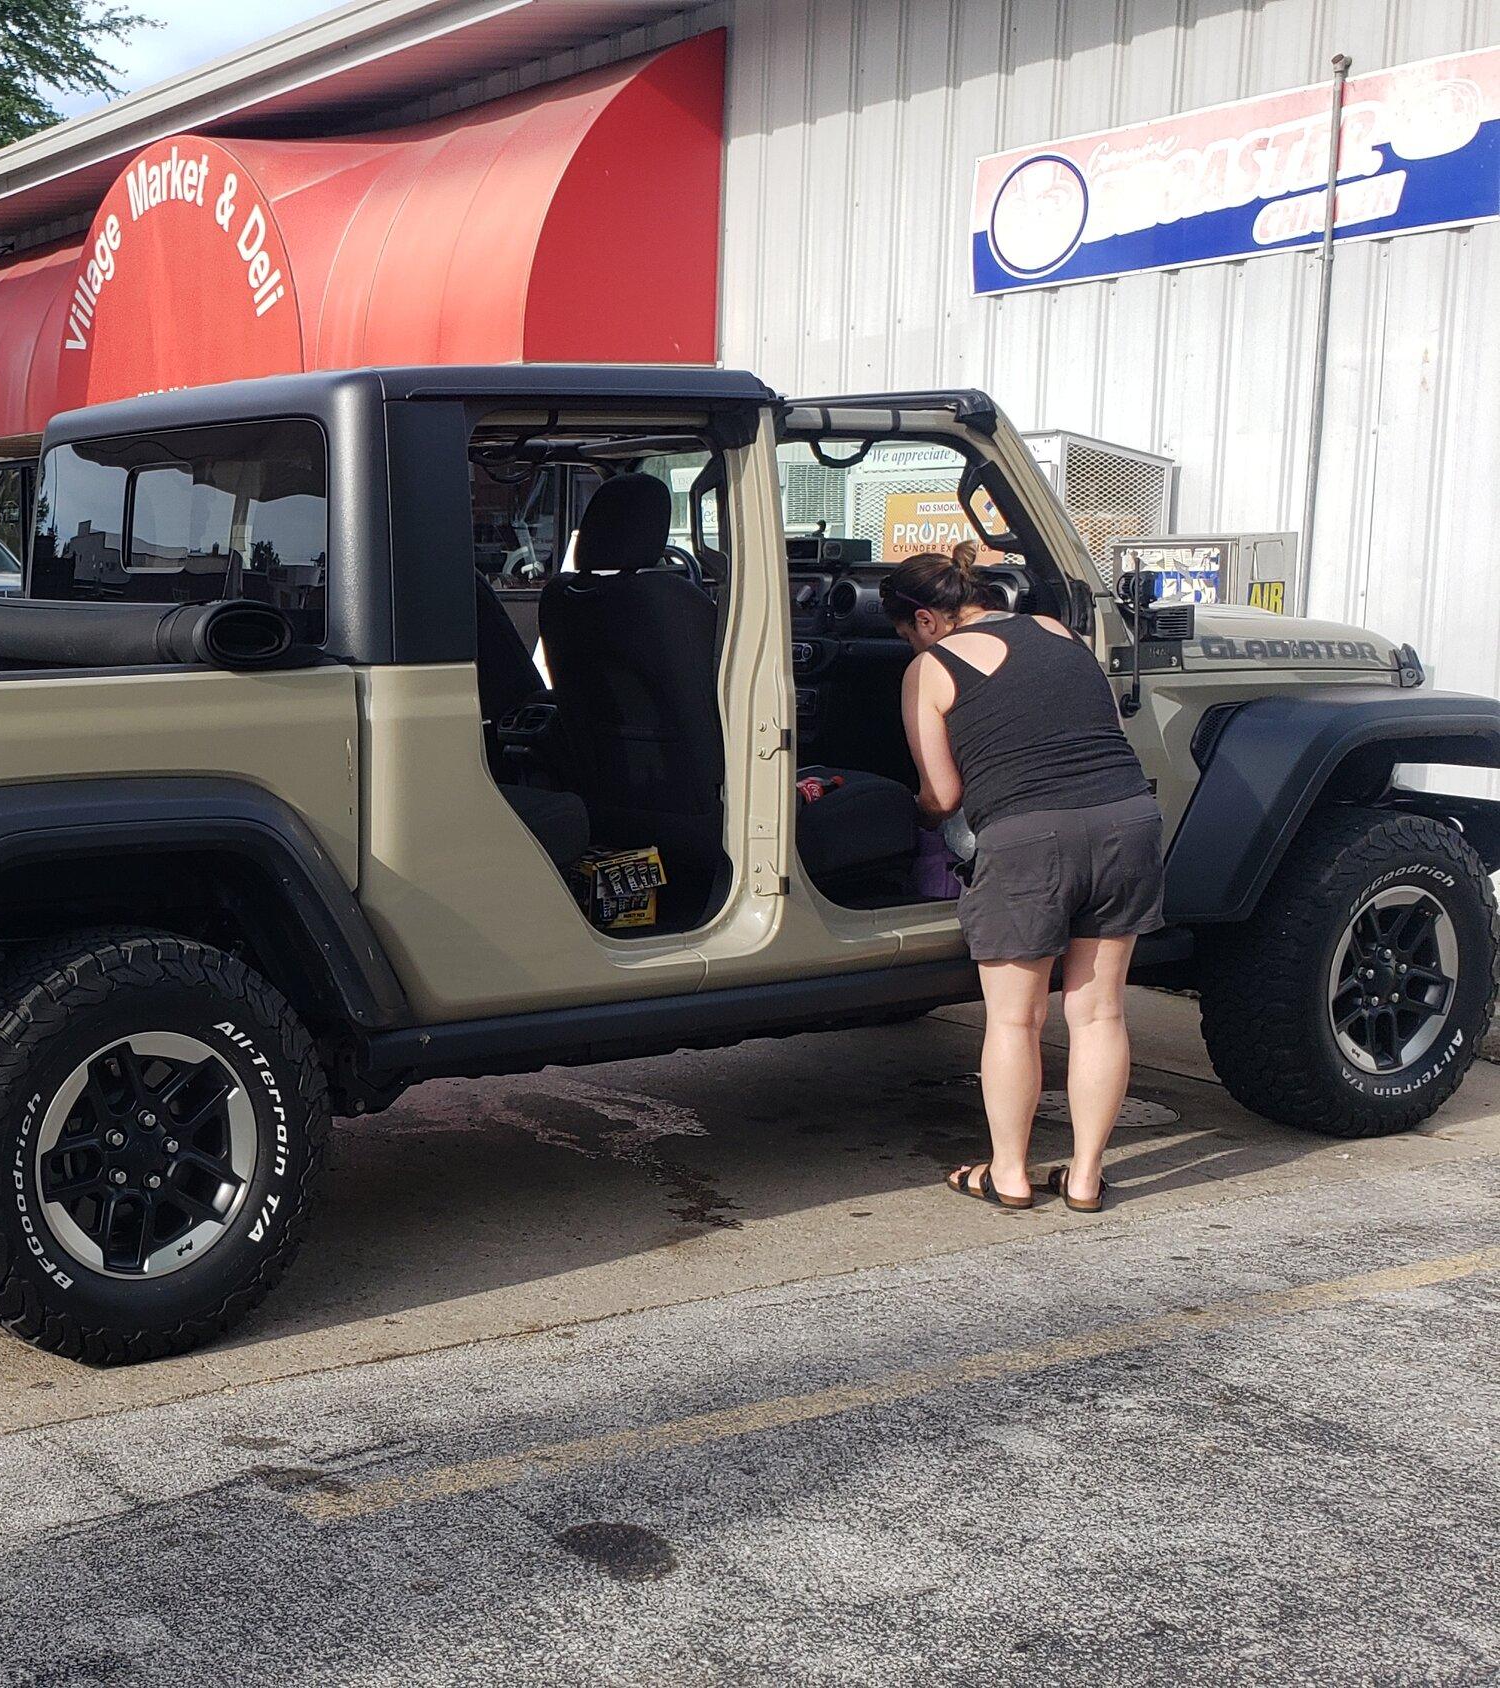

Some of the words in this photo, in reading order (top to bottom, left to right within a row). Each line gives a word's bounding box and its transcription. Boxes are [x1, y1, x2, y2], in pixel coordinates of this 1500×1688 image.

[65, 214, 121, 350] Village
[126, 146, 209, 221] Market
[215, 173, 237, 232] &
[237, 204, 284, 317] Deli
[892, 447, 951, 465] appreciate
[918, 503, 931, 512] NO
[932, 502, 963, 512] SMOKIN
[892, 543, 937, 553] CYLINDER
[1250, 583, 1285, 615] AIR
[1201, 637, 1382, 662] GLADIATOR
[1373, 1028, 1464, 1098] All-Terrain
[1340, 1066, 1366, 1096] T/A
[213, 1020, 291, 1177] All-Terrain
[13, 1091, 75, 1290] BFGoodrich
[247, 1192, 282, 1243] T/A
